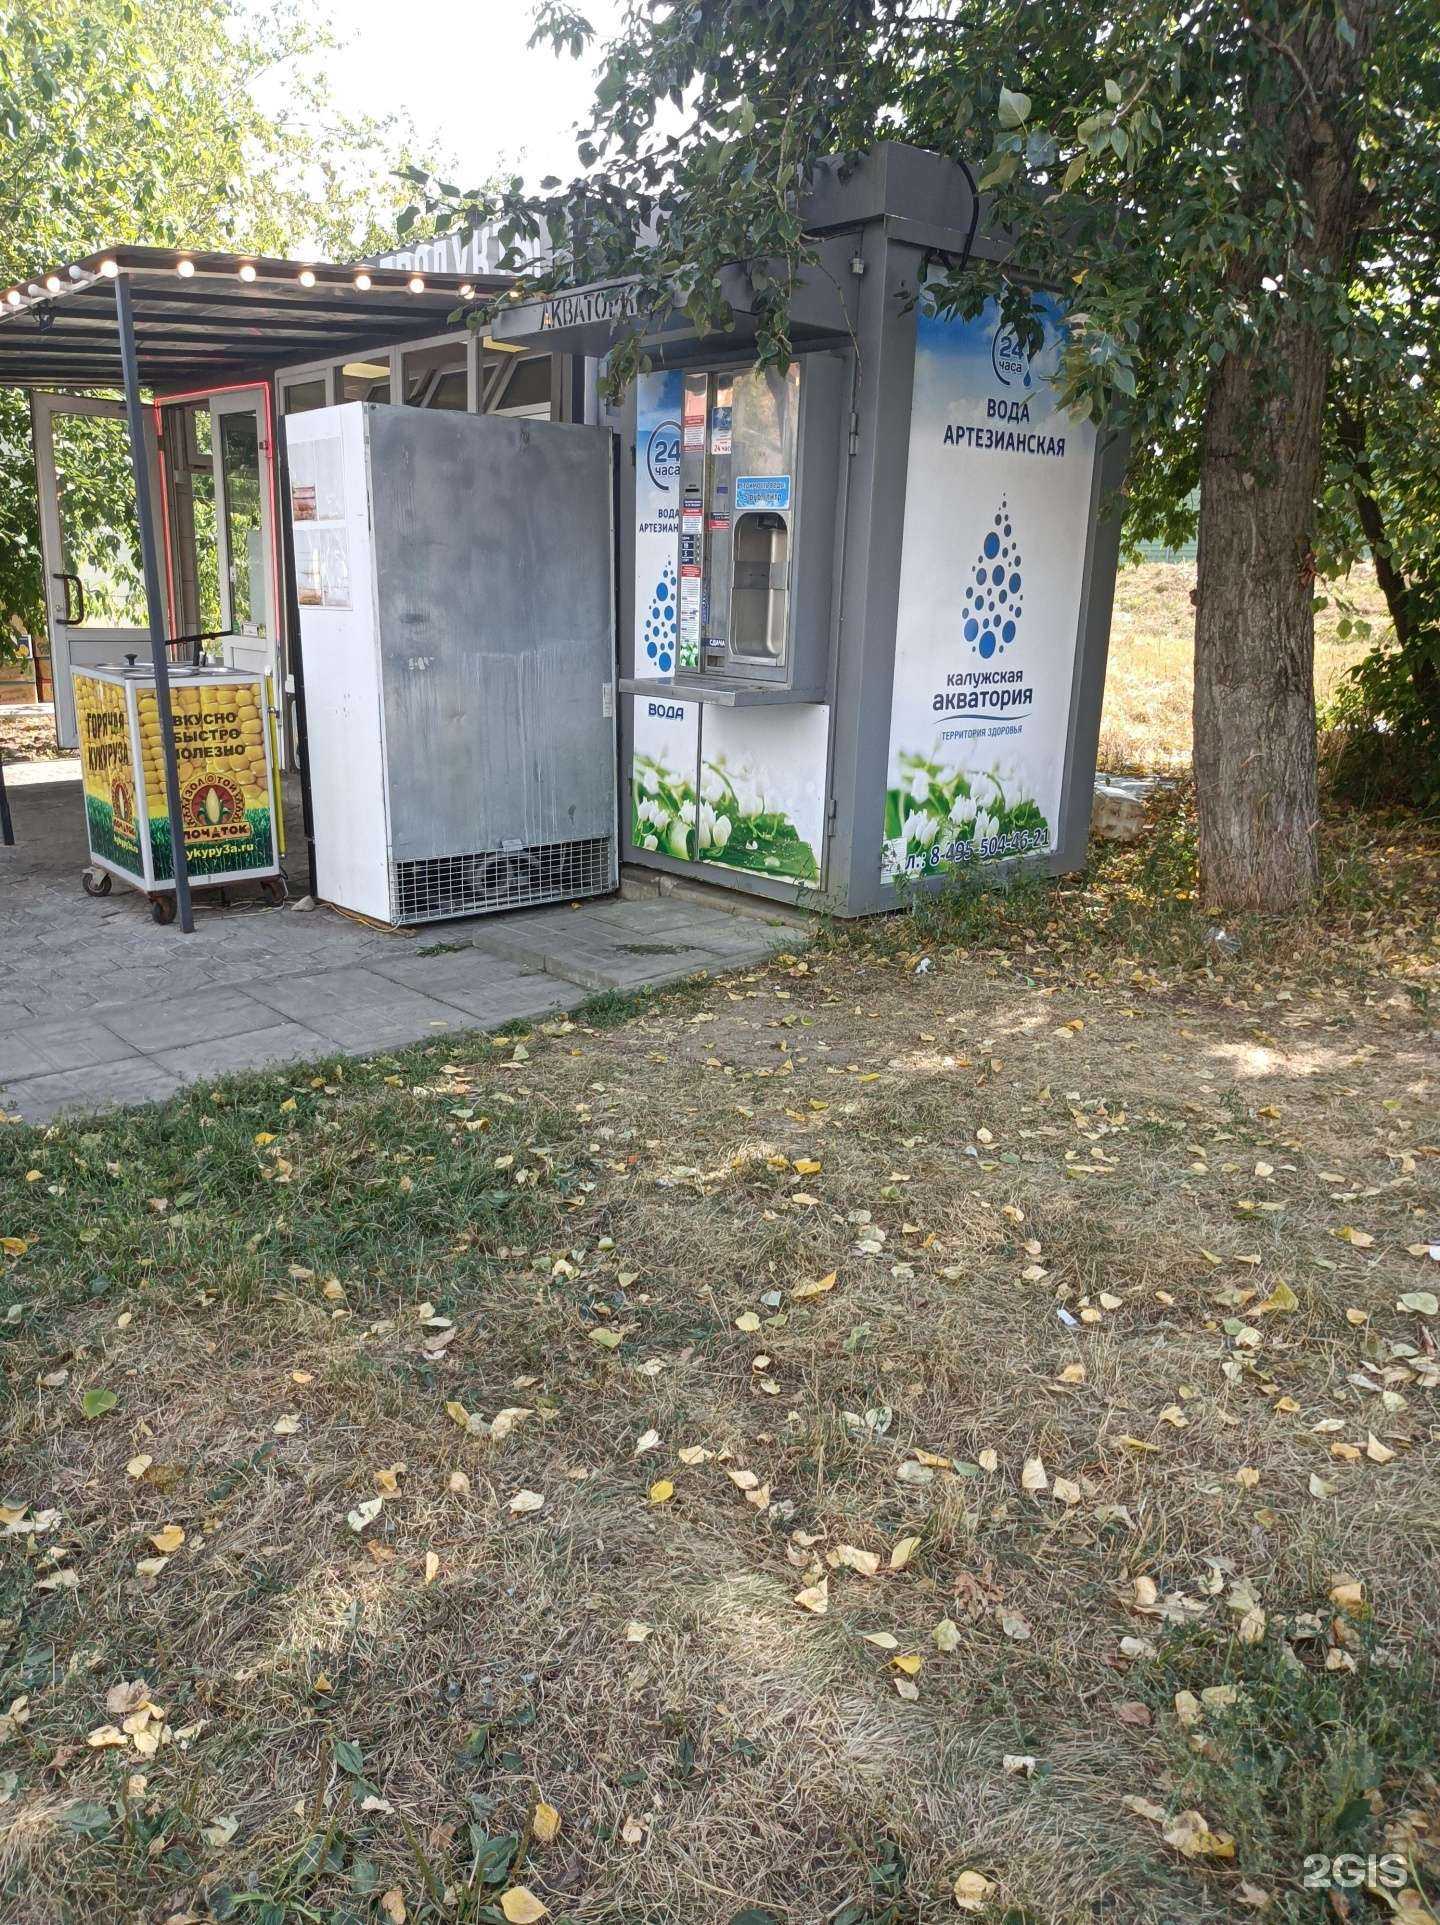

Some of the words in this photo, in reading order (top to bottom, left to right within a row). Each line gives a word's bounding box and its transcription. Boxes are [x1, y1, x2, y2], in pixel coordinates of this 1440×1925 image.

[1000, 336, 1024, 359] 24
[999, 361, 1022, 374] часа
[986, 398, 1030, 424] ВОДА
[943, 425, 1066, 457] АРТЕЗИАНСКАЯ
[655, 441, 680, 463] 24
[655, 466, 680, 476] часа
[658, 508, 680, 519] ВОДА
[947, 670, 1024, 689] калужская
[932, 687, 1034, 711] акватория
[172, 712, 238, 727] ВКУСНО
[648, 703, 684, 720] ВОДА
[87, 712, 125, 739] ГОРЯЧАЯ
[942, 727, 986, 741] ТЕРРИТОРИЯ
[987, 725, 1023, 737] ЗДОРОВЬЯ
[174, 728, 241, 744] БЫСТРО
[88, 742, 129, 771] КУКУРУЗА
[185, 774, 237, 798] ЗОЛОТОЙ
